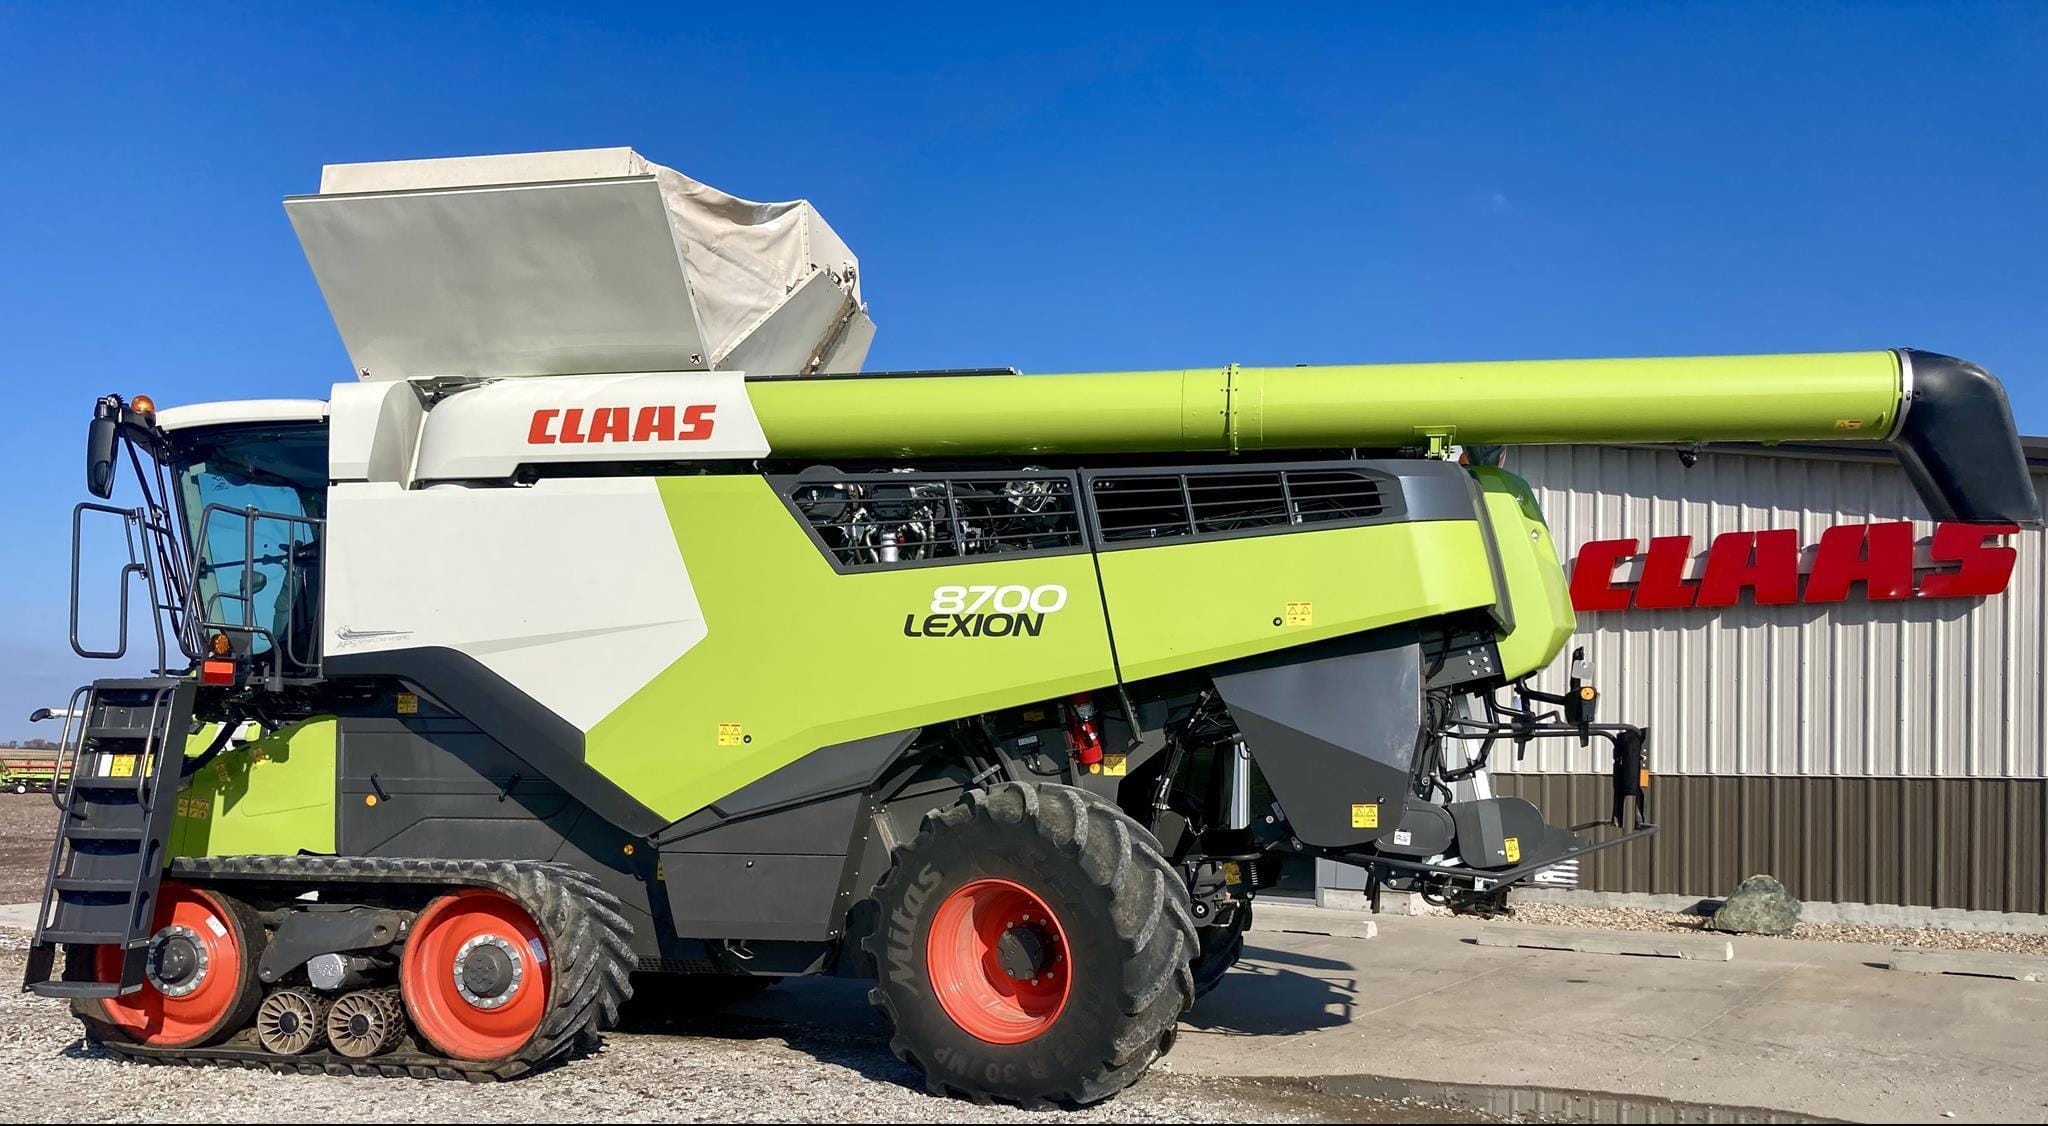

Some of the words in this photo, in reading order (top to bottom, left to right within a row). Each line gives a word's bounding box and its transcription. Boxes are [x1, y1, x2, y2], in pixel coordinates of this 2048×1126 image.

[528, 405, 717, 444] CLAAS
[1569, 521, 2021, 612] CLAAS
[930, 584, 1068, 614] 8700
[904, 613, 1045, 637] LEXION
[887, 862, 943, 996] Mitas
